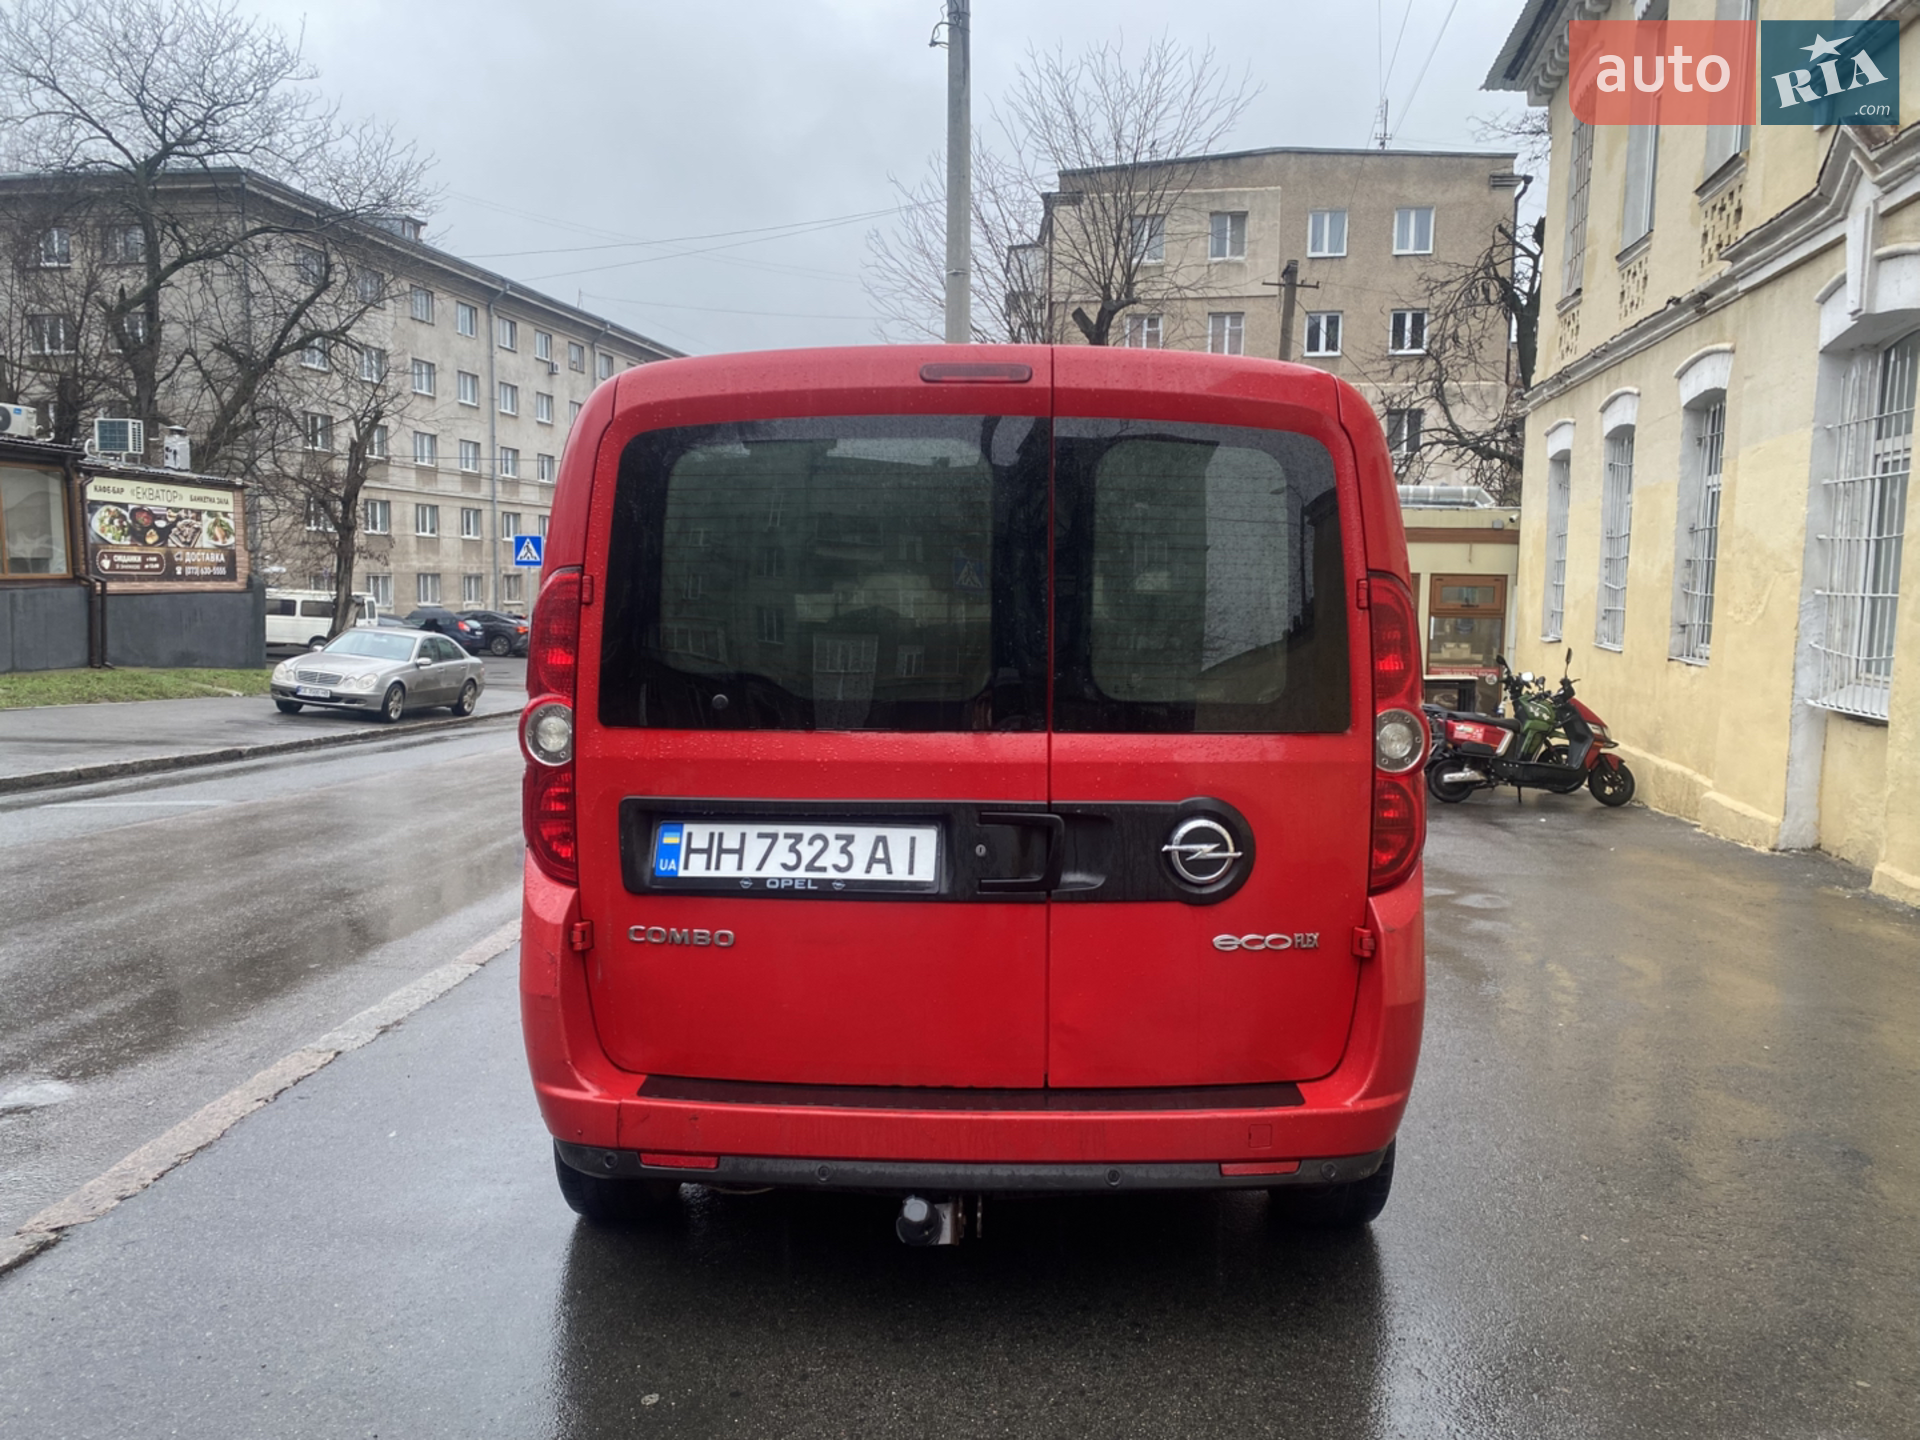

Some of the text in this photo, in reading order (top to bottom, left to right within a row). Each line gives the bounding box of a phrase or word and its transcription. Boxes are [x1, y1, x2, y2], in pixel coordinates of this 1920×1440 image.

[94, 485, 125, 496] КАФЕ-БАР
[185, 551, 225, 563] ДОСТАВКА
[755, 832, 856, 874] 7323
[659, 858, 677, 872] UA
[766, 878, 818, 890] OPEL
[628, 925, 735, 947] COMBO
